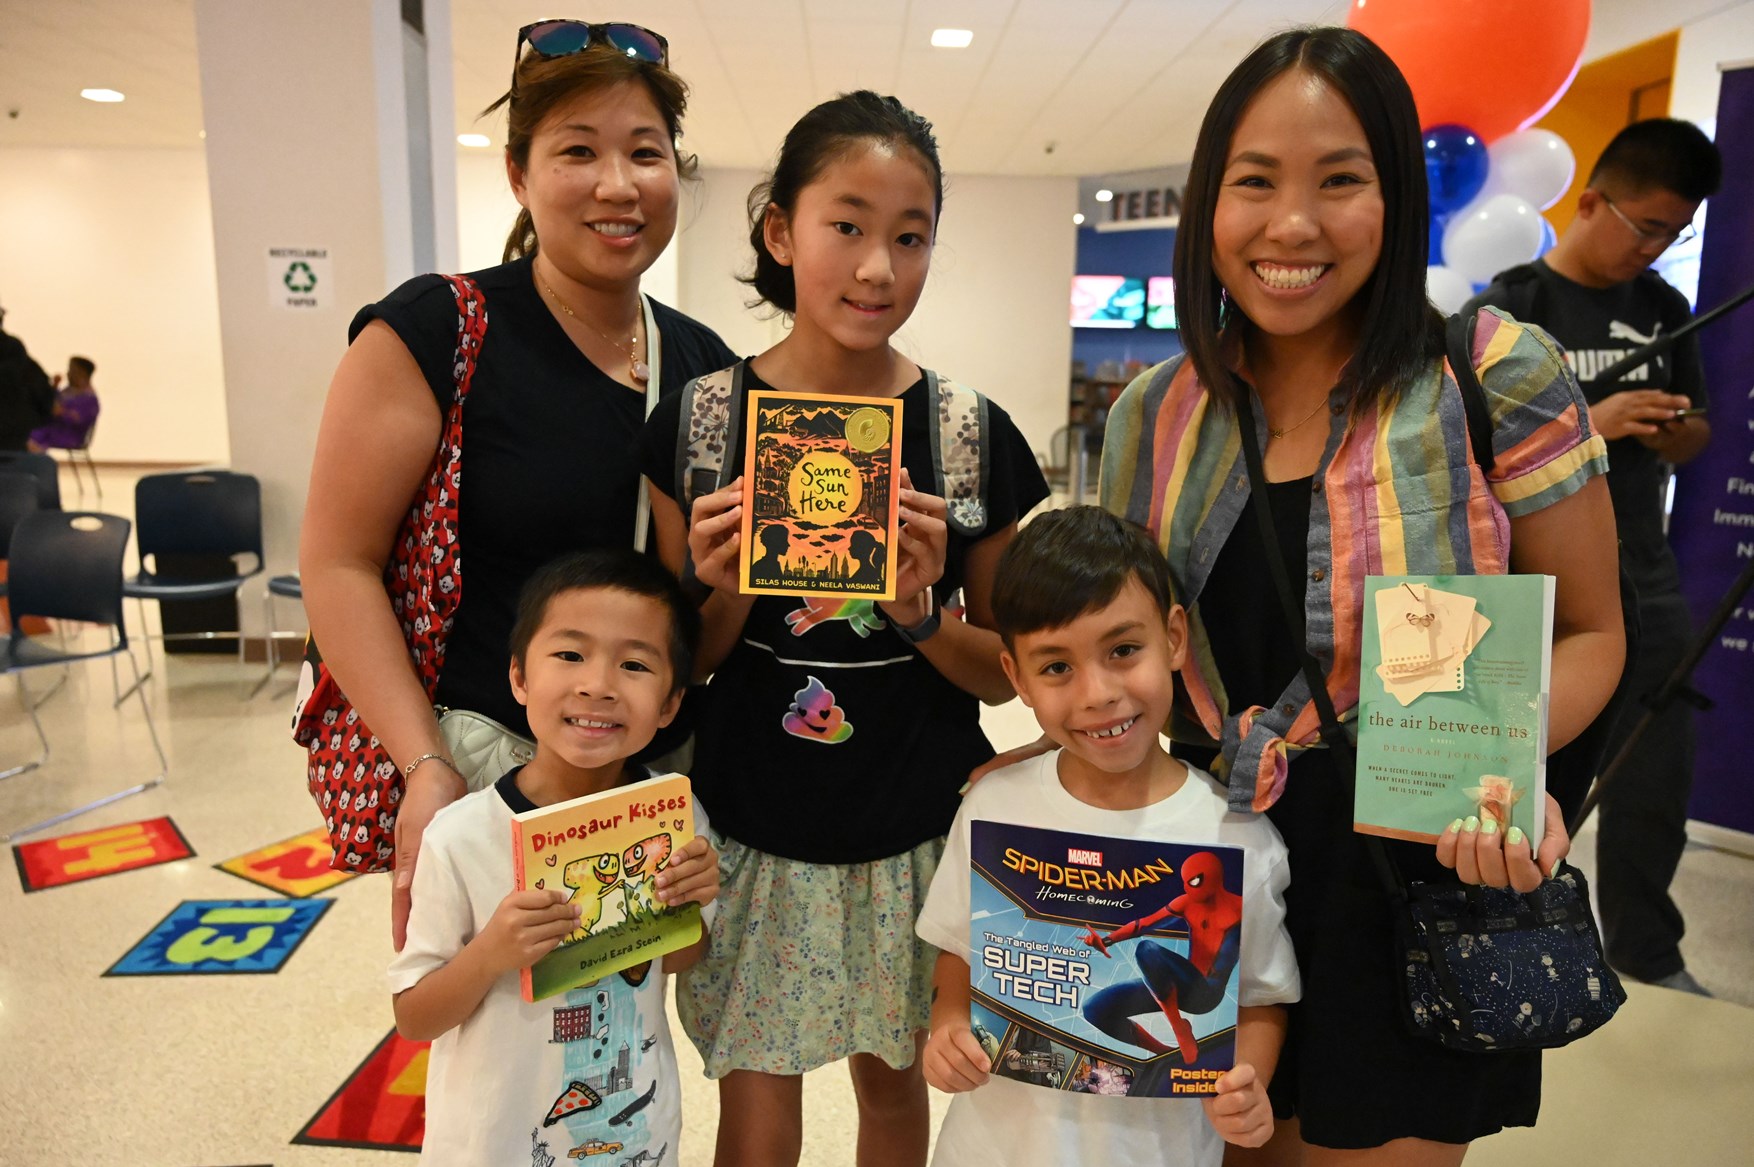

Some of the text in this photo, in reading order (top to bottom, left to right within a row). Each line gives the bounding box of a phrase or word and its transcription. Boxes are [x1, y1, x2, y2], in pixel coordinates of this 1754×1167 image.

[800, 462, 851, 486] Same
[816, 478, 849, 496] Sun
[800, 490, 847, 515] Here
[755, 578, 780, 586] SILAS
[782, 580, 808, 588] HOUSE
[846, 583, 881, 591] VASWANI
[1369, 711, 1528, 739] the air between us
[1383, 744, 1509, 765] DEBORAH JOHNSON
[1390, 767, 1409, 775] SECRET
[1391, 777, 1411, 785] HEARTS
[531, 795, 687, 852] Dinosaur Kisses
[1002, 847, 1174, 892] SPIDER-MAN
[1068, 848, 1103, 867] MARVEL
[579, 933, 662, 971] David Ezra Stein
[984, 932, 1091, 959] The Tangled Web of
[983, 945, 1091, 986] SUPER
[992, 972, 1079, 1009] TECH
[1173, 1082, 1217, 1093] Inside
